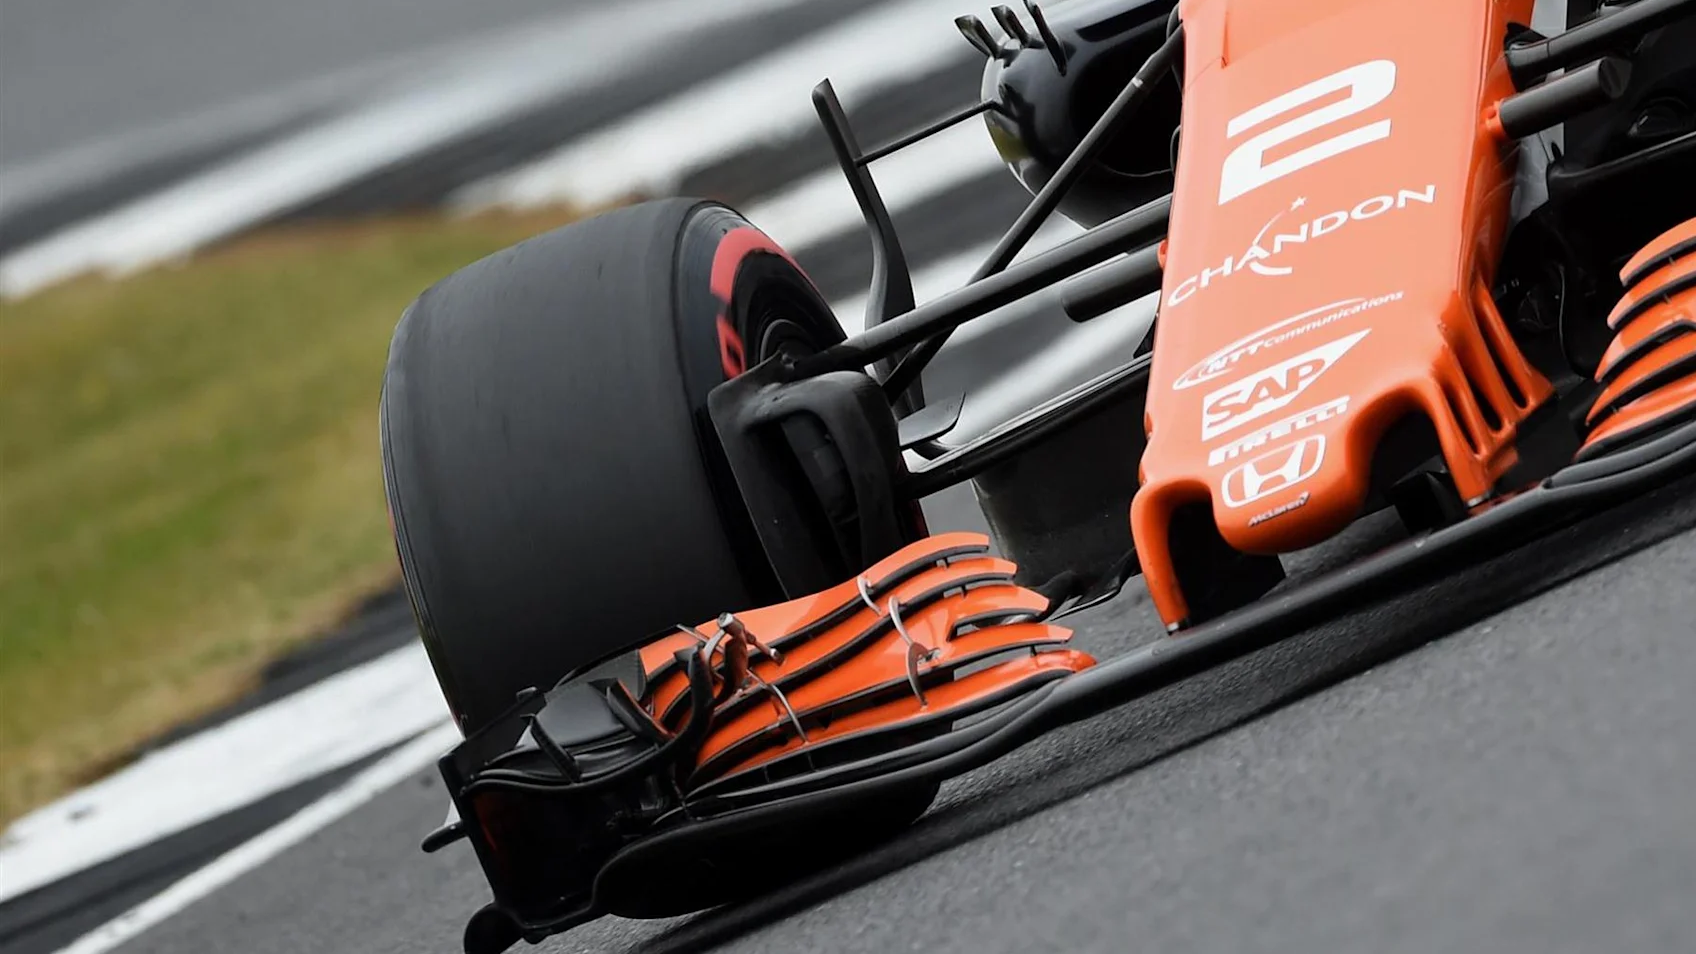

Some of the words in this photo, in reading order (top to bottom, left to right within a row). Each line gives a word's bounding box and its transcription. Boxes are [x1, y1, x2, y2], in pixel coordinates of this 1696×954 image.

[1218, 59, 1397, 206] 2
[1167, 184, 1437, 308] CHANDON
[1205, 357, 1326, 429] SAP
